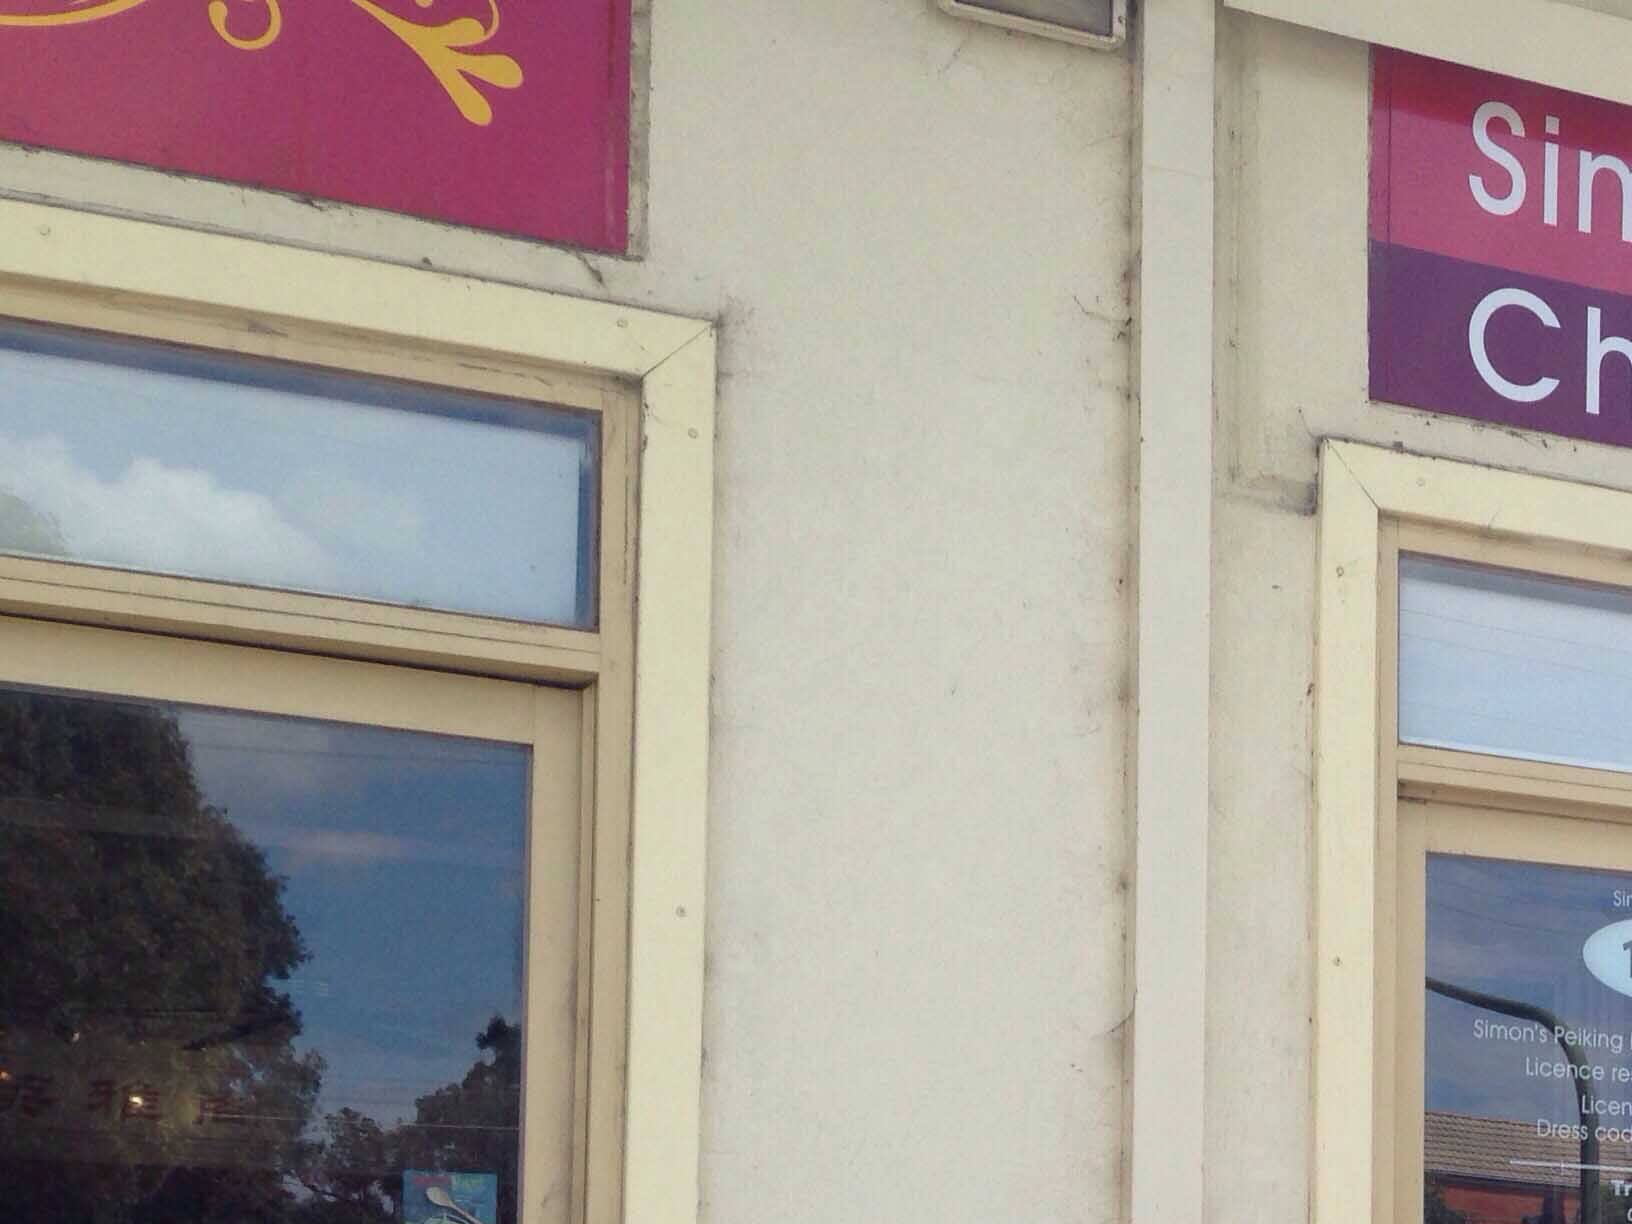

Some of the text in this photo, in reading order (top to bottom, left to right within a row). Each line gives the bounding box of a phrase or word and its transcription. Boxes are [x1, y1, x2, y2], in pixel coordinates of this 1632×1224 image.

[1472, 1019, 1548, 1045] Simon's
[1554, 1025, 1624, 1054] Peiking
[1525, 1056, 1605, 1081] Licence
[1537, 1119, 1588, 1141] Dress
